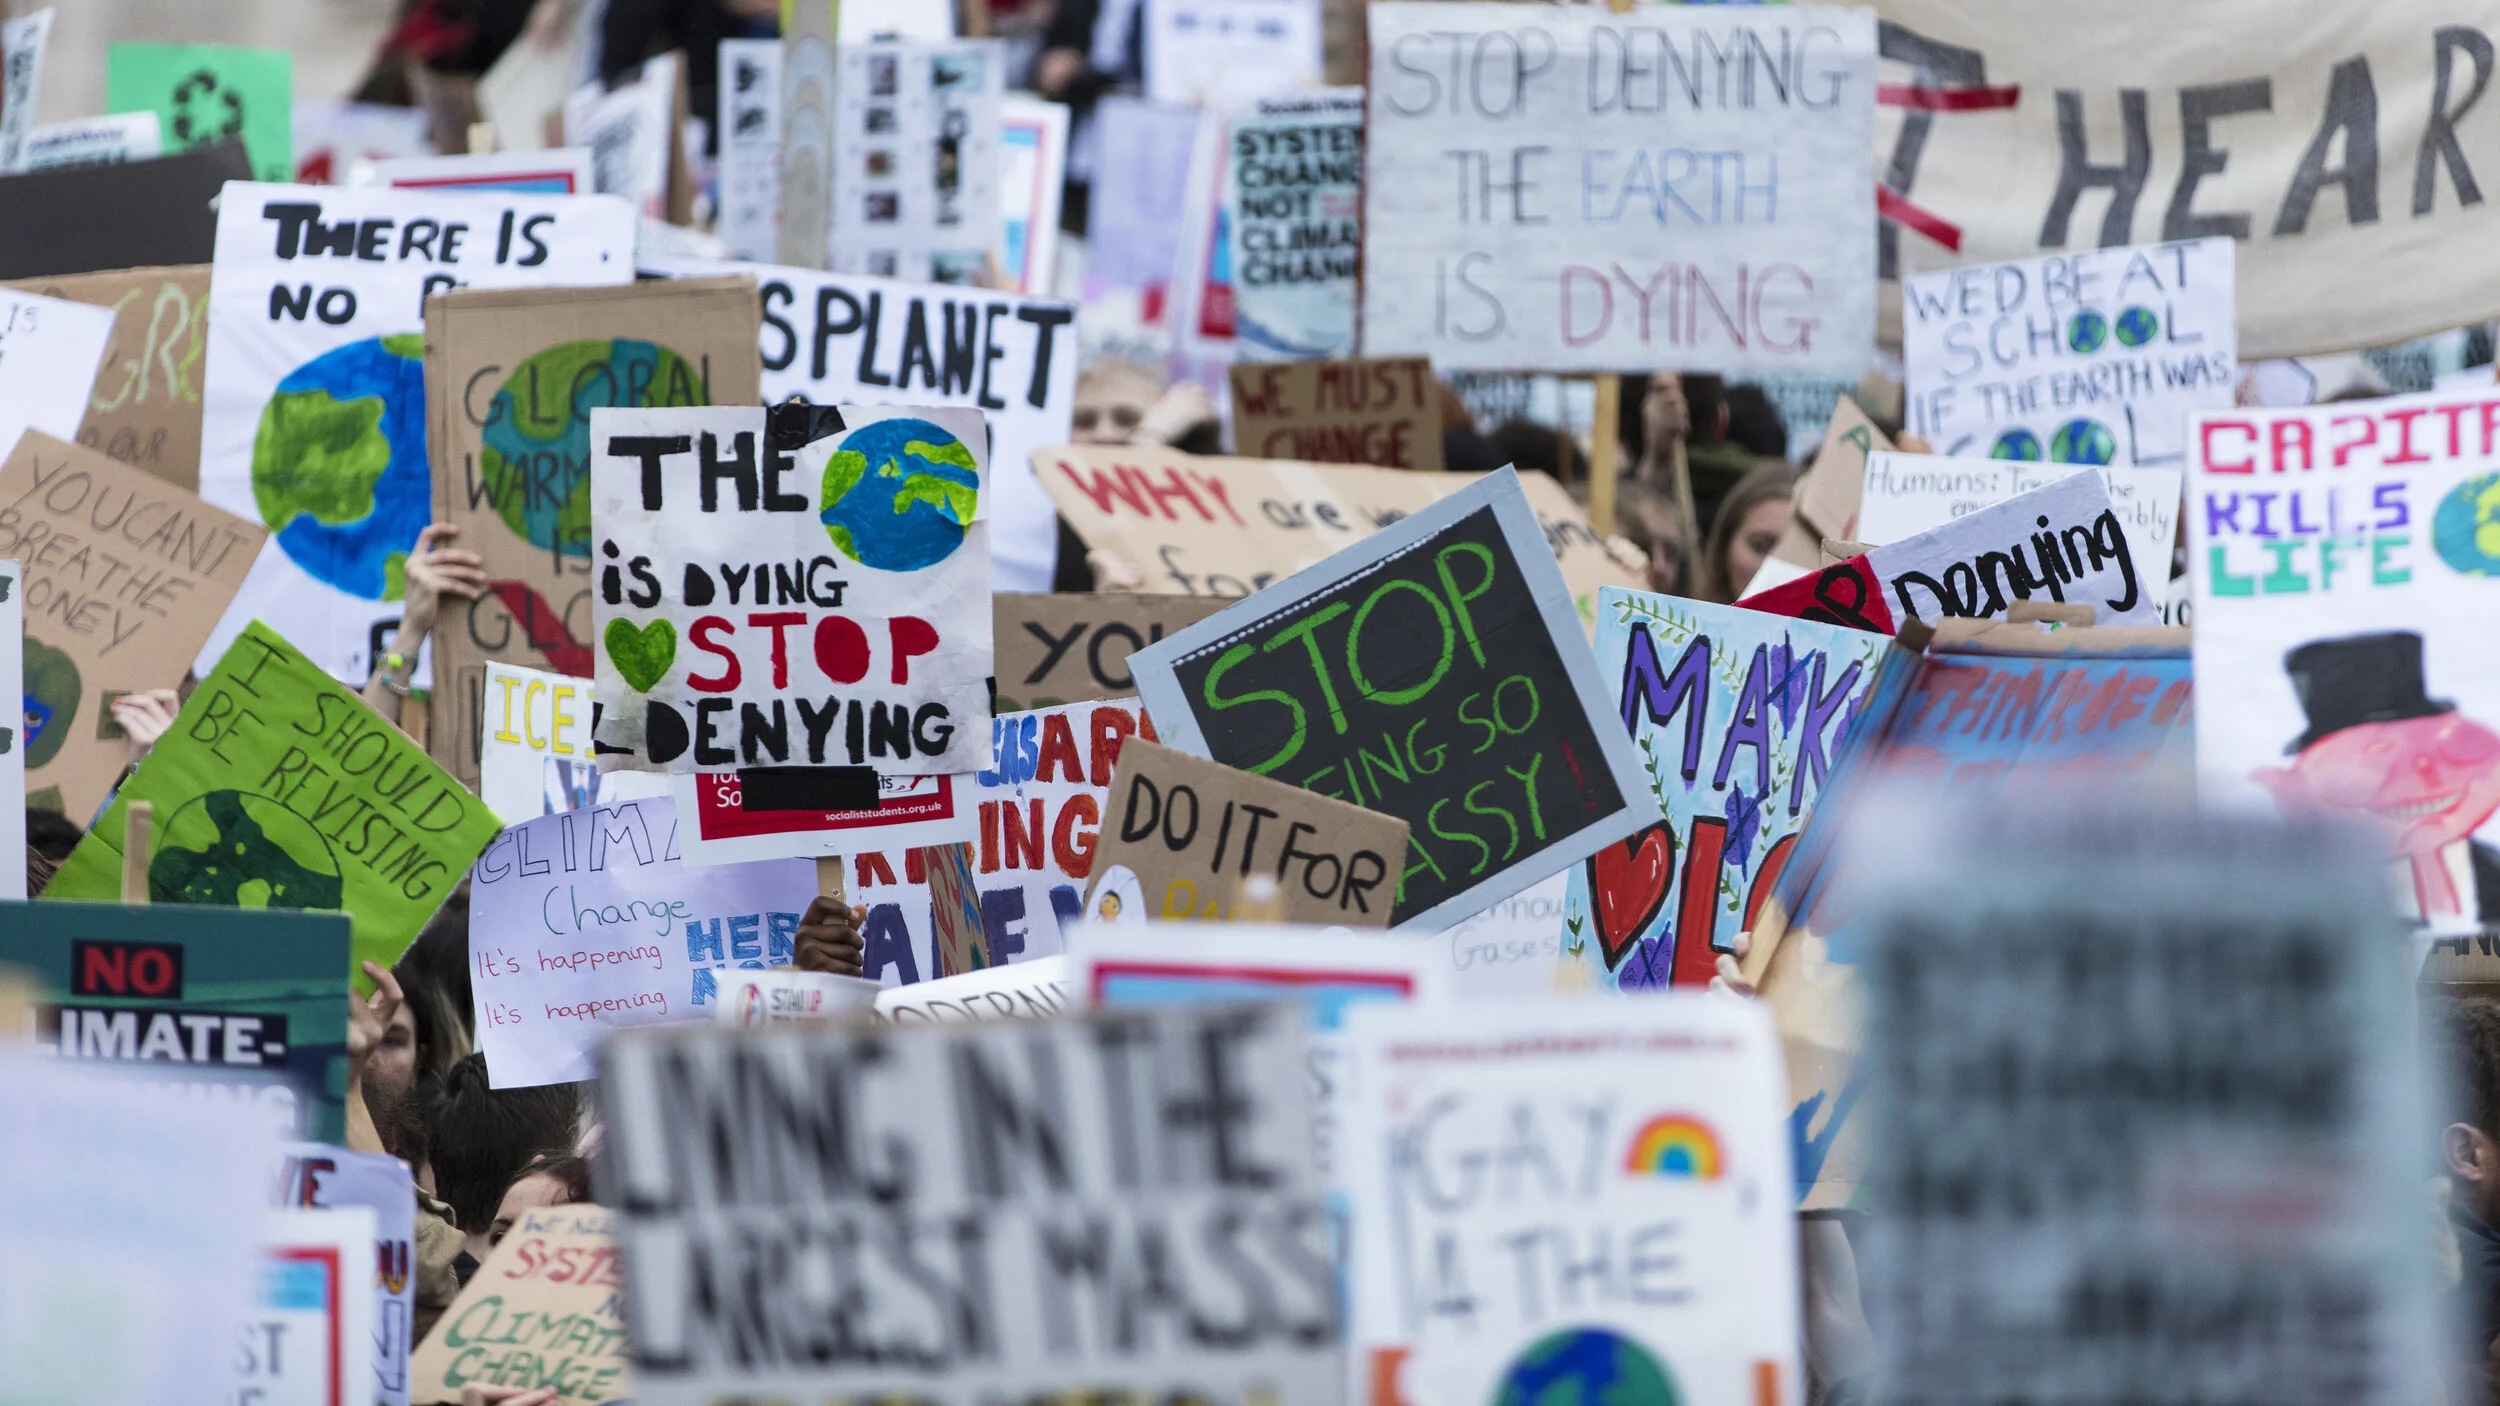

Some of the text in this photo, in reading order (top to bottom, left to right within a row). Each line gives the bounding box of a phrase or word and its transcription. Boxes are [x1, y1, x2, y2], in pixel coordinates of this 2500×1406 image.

[1385, 25, 1853, 120] STOP DENYING
[2039, 25, 2495, 248] HEAR
[1443, 145, 1779, 226] THE EARTH
[263, 203, 556, 266] THERE IS
[2044, 256, 2103, 308] BE
[2116, 241, 2204, 299] AT
[269, 283, 357, 325] NO
[1434, 251, 1822, 353] IS DYING
[810, 286, 1074, 410] PLANET
[1231, 365, 1293, 417] WE
[1315, 357, 1430, 414] MUST
[1974, 375, 2044, 420] THE
[2049, 358, 2154, 402] EARTH
[2160, 350, 2229, 388] WAS
[607, 431, 809, 513] THE
[1057, 460, 1248, 528] WHY
[1259, 499, 1350, 532] are
[2205, 482, 2411, 539] KILLS
[0, 506, 196, 618] BREATHE
[683, 555, 849, 608] DYING
[1892, 508, 2138, 622] Denying
[2209, 536, 2412, 598] LIFE
[22, 566, 145, 657] ONEY
[686, 612, 941, 694] STOP
[1204, 541, 1495, 776] STOP
[228, 634, 289, 699] I
[292, 691, 467, 834] SHOULD
[494, 674, 576, 755] ICE
[645, 695, 955, 766] DENYING
[1458, 674, 1541, 755] SO
[189, 690, 449, 901] BE REVISING
[825, 800, 942, 822] socialiststudents.org.uk
[1121, 772, 1200, 852] DO
[1211, 800, 1279, 877] IT
[1278, 821, 1388, 914] FOR
[83, 945, 176, 995] NO
[477, 948, 521, 979] It's
[538, 943, 663, 975] happening
[485, 991, 668, 1029] It's happening
